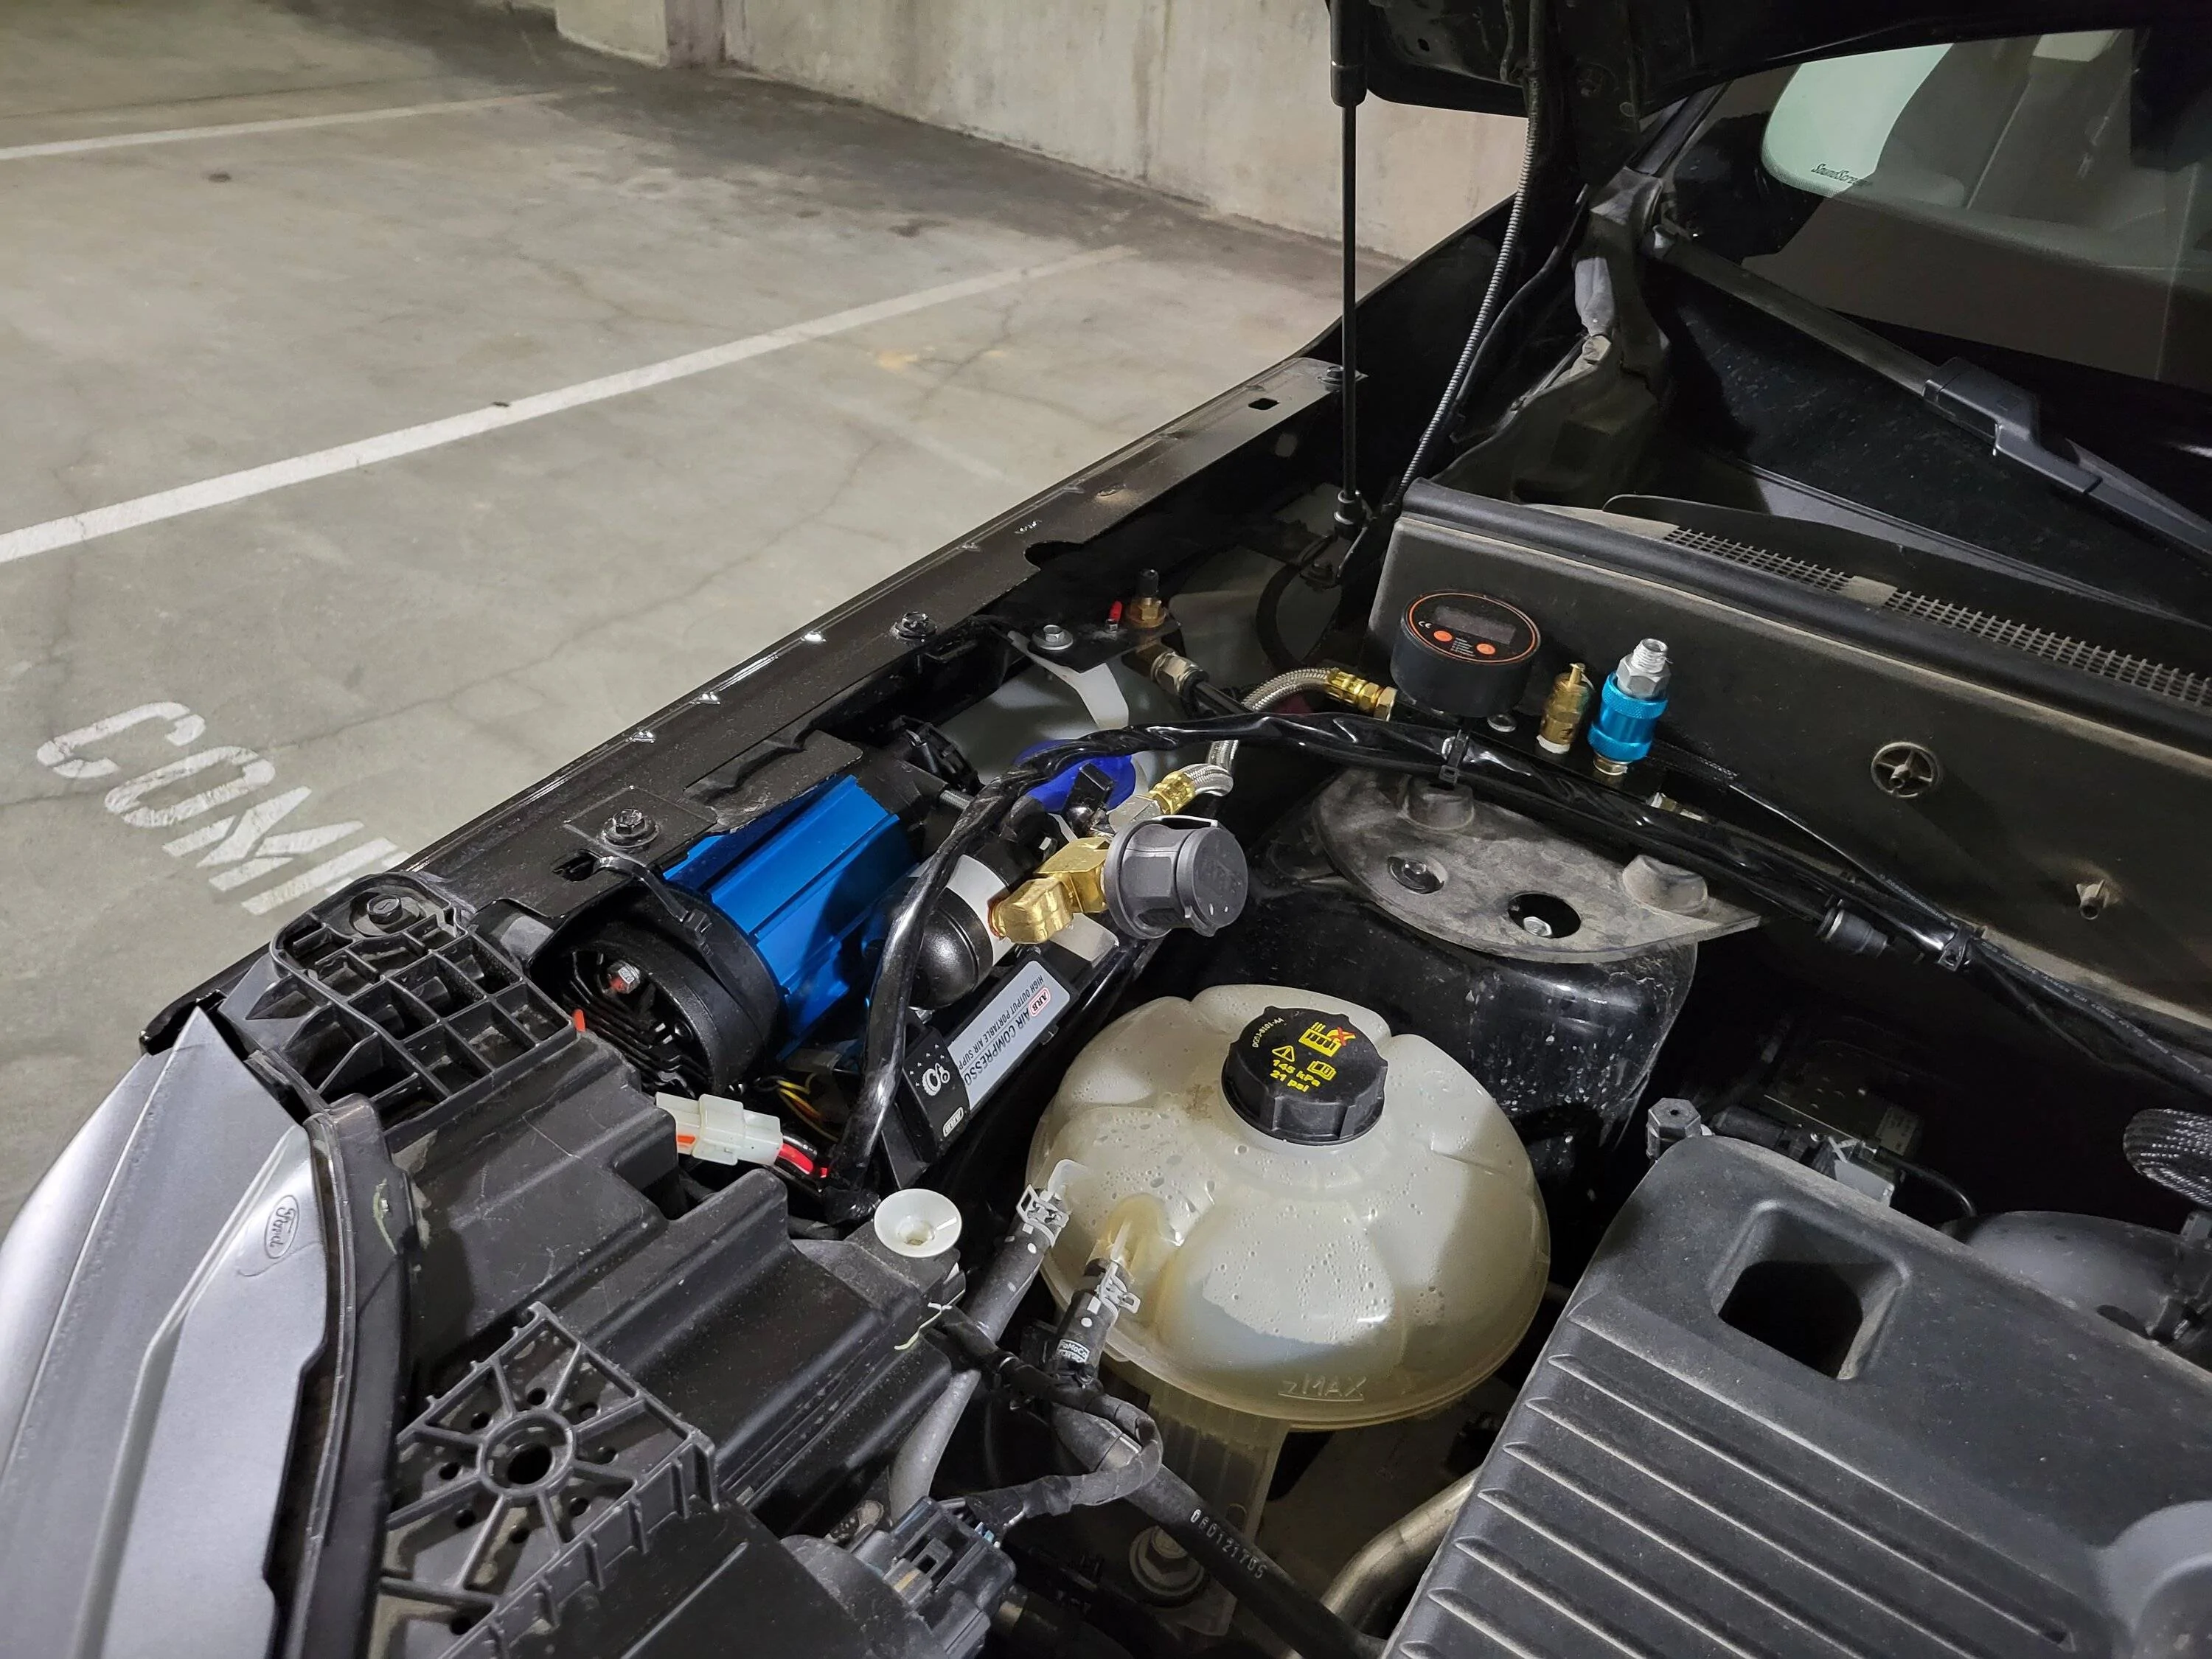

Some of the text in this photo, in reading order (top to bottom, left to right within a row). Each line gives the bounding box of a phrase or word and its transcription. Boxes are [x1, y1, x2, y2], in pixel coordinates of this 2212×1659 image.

[1029, 975, 1044, 995] HIGH
[1010, 987, 1031, 1015] OUTPUT
[1032, 992, 1047, 1012] ARB
[984, 1009, 1011, 1043] PORTABLE
[1016, 1007, 1030, 1029] AIR
[974, 1037, 984, 1054] AIR
[1273, 1060, 1321, 1087] 145 kPa
[1287, 1079, 1310, 1092] psi
[269, 1207, 296, 1248] Ford
